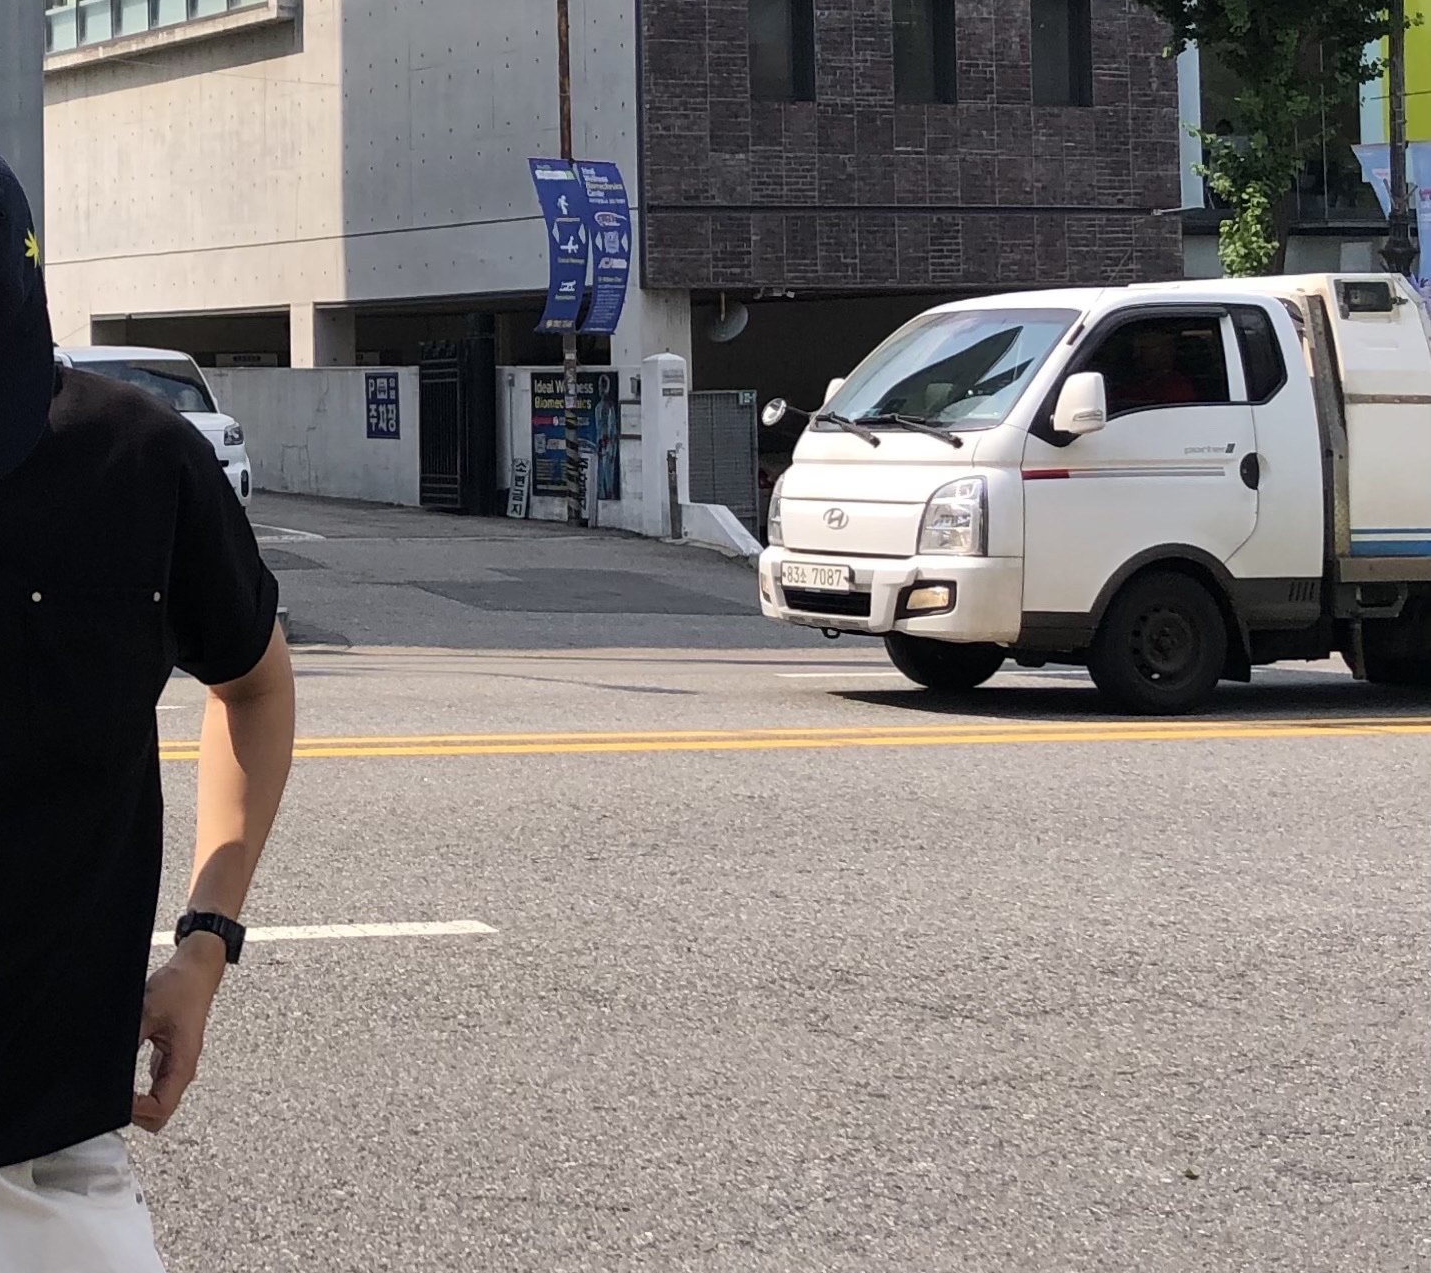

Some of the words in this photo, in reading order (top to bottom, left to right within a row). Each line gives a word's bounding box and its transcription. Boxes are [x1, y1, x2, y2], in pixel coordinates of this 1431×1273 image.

[368, 378, 375, 400] P
[534, 378, 554, 394] Ideal
[534, 395, 592, 410] Biomecnics
[369, 403, 397, 432] 주차장
[510, 459, 527, 516] 소변금지
[786, 565, 807, 584] 83소
[811, 567, 842, 587] 7087
